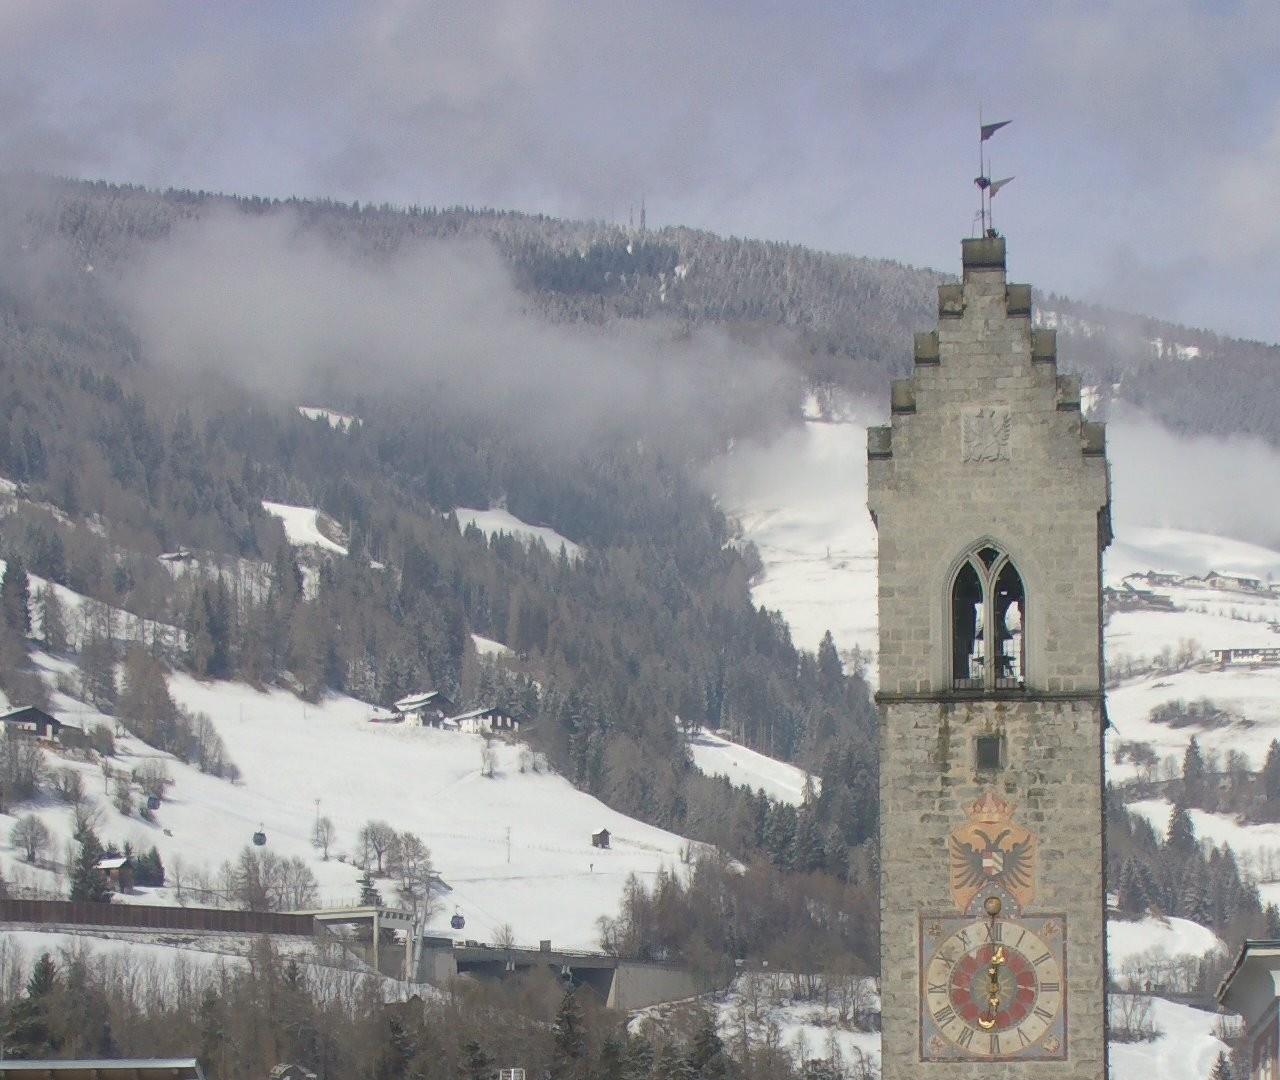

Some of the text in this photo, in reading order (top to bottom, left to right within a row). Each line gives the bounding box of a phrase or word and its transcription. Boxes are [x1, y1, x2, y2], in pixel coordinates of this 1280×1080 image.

[1015, 930, 1026, 948] I
[934, 951, 956, 970] X
[1032, 952, 1051, 966] II
[928, 982, 947, 994] IX
[1040, 982, 1060, 992] III
[957, 1026, 975, 1049] VII
[989, 1034, 1001, 1055] VI
[1016, 1026, 1032, 1047] V
